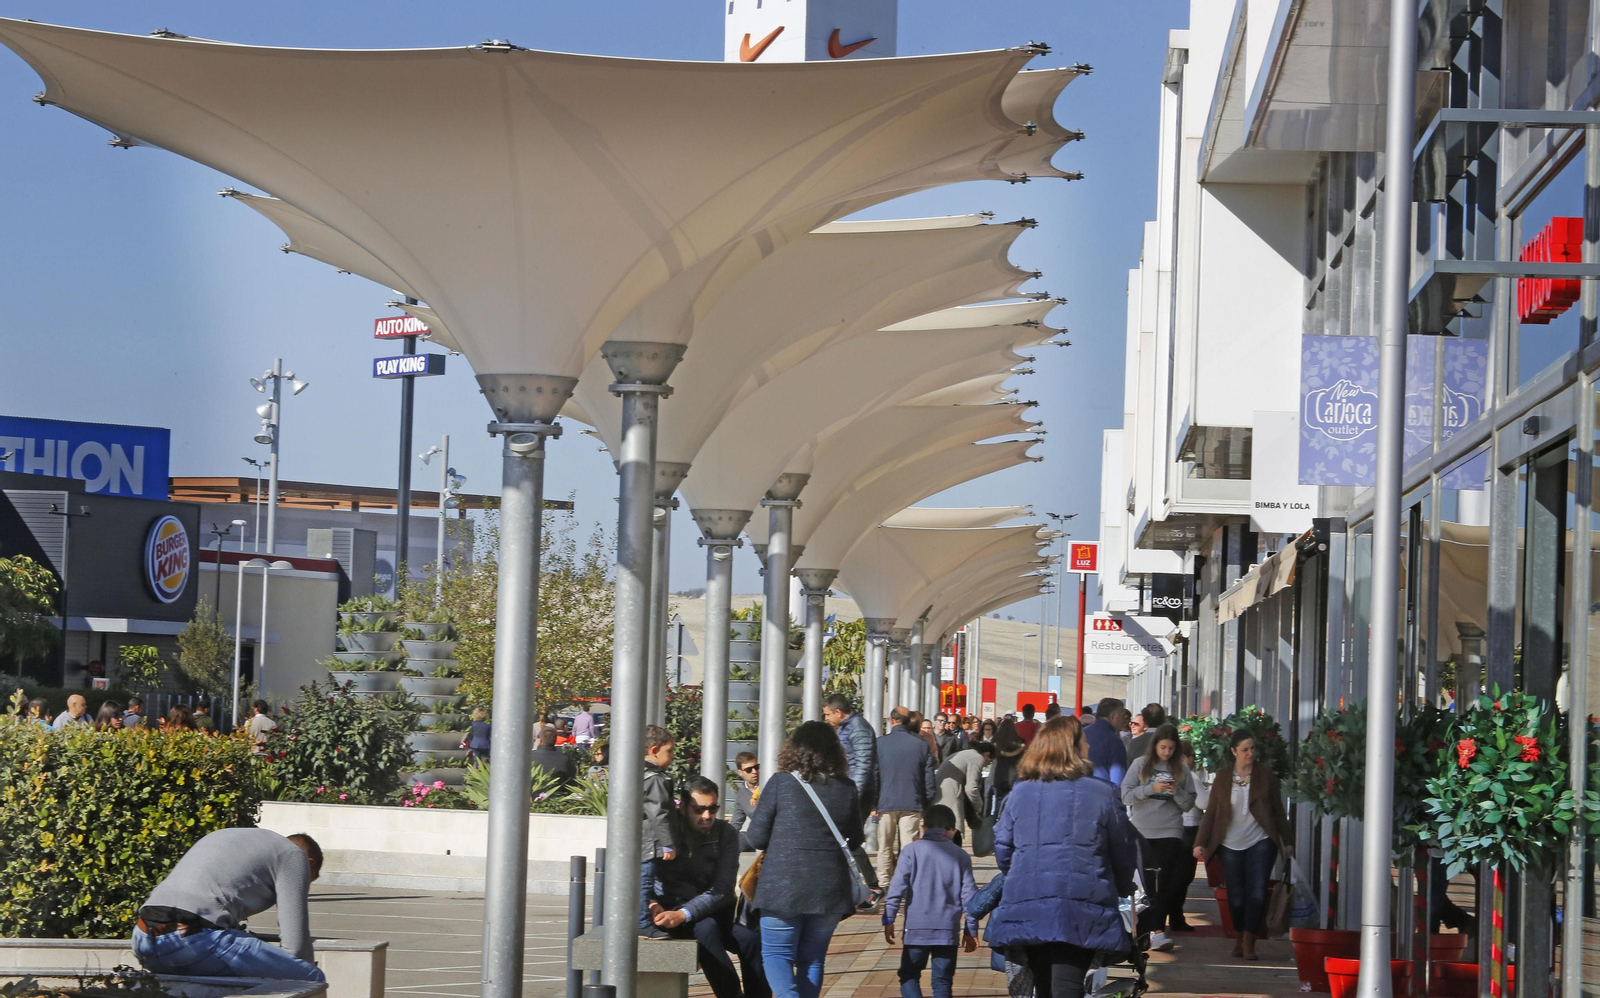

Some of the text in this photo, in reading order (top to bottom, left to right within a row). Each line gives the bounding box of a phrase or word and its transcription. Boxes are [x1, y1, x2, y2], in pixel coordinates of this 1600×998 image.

[1330, 383, 1360, 400] New
[1315, 392, 1372, 425] Carioca
[1327, 425, 1359, 435] outlet
[1255, 501, 1281, 509] BIMBA
[156, 531, 187, 560] BURGER
[156, 547, 188, 582] KING
[1091, 640, 1164, 652] Restaurantes
